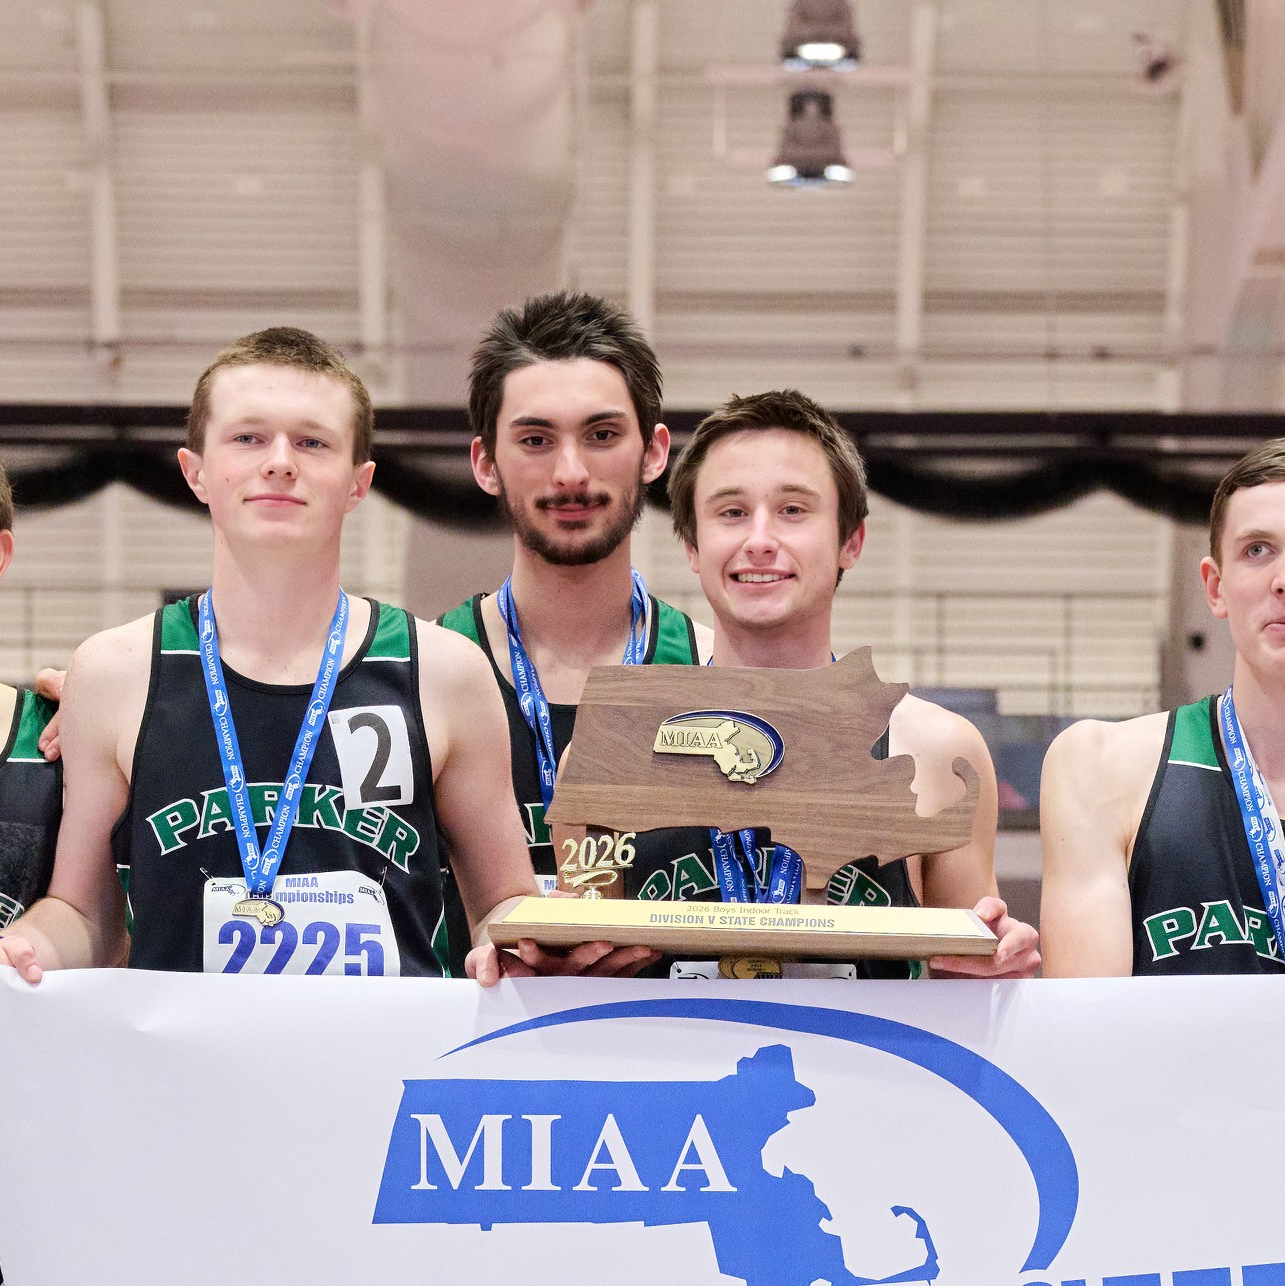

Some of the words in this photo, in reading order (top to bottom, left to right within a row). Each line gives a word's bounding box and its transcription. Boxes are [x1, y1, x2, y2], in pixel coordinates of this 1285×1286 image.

[205, 643, 219, 685] CHAMPION
[317, 658, 335, 700] CHAMPION
[515, 651, 529, 692] CHAMPION
[219, 716, 235, 761] CHAMPION
[660, 730, 724, 749] MIAA
[1225, 706, 1237, 744] CHAMPION
[294, 729, 314, 774] CHAMPION
[348, 712, 402, 803] 2
[1238, 770, 1254, 812] CHAMPION
[146, 782, 421, 874] PARKER
[235, 793, 251, 838] CHAMPION
[272, 804, 291, 849] CHAMPION
[560, 832, 637, 871] 2026
[719, 848, 735, 892] CHAMPION
[1256, 842, 1272, 887] CHAMPION
[285, 877, 319, 888] MIAA
[649, 913, 704, 924] DIVISION
[707, 915, 716, 925] V
[719, 915, 756, 926] STATE
[759, 916, 835, 928] CHAMPIONS
[686, 905, 710, 913] 2026
[714, 906, 736, 914] Boys
[739, 906, 771, 914] Indoor
[775, 907, 800, 915] Track
[218, 920, 385, 977] 2225
[411, 1113, 738, 1192] MIAA
